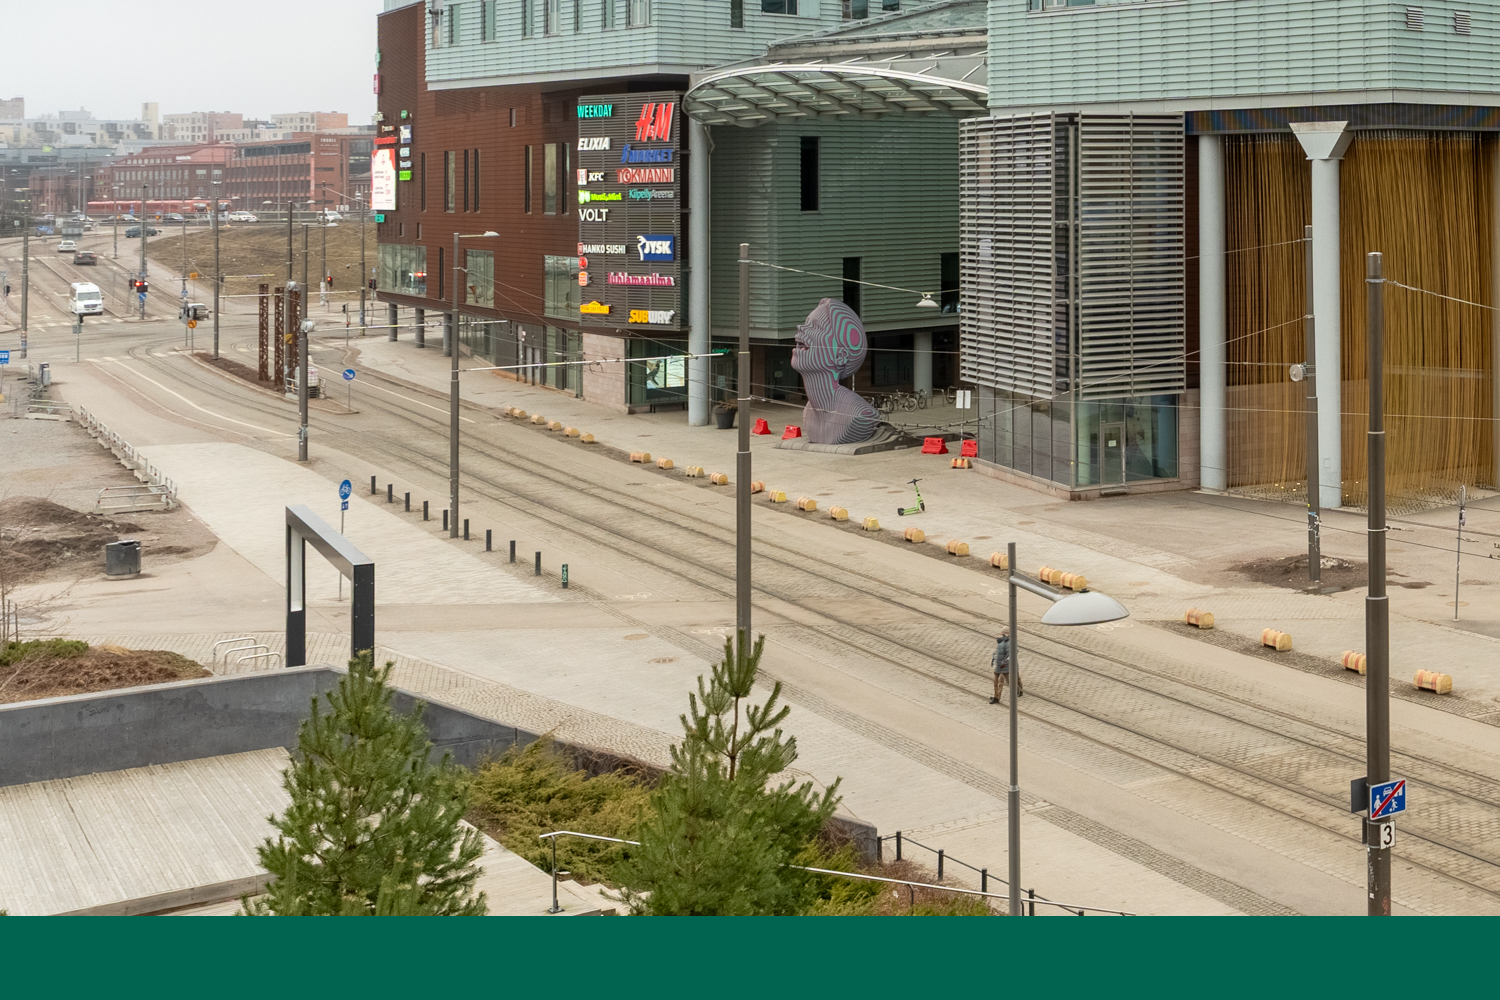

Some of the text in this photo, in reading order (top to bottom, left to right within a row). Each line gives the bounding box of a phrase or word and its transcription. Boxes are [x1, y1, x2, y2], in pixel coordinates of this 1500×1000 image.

[577, 104, 612, 118] WEEKDAY
[635, 102, 674, 142] H&M
[577, 137, 610, 150] ELIXIA
[588, 172, 604, 181] KFC
[615, 168, 674, 184] TOKMANNI
[578, 209, 608, 221] VOLT
[583, 245, 626, 254] HANKO SUSHI
[644, 241, 672, 254] JYSK
[628, 310, 675, 324] SUBWAY
[1383, 824, 1392, 845] 3
